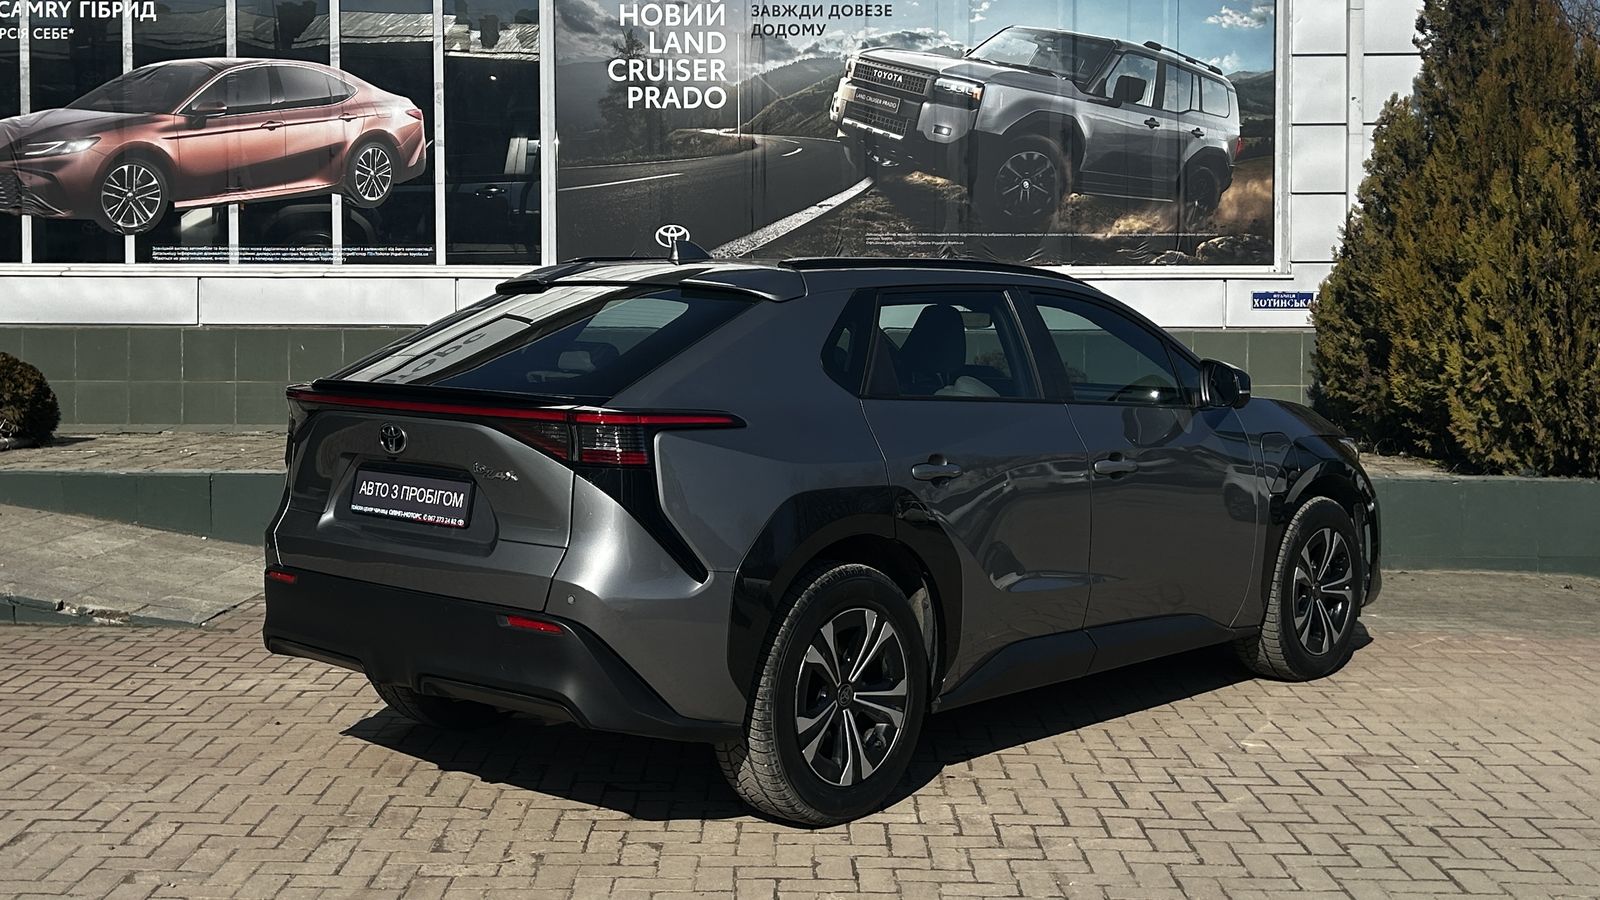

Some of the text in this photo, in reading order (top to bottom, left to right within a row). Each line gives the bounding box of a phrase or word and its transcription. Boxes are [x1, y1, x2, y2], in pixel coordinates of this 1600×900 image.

[0, 1, 157, 21] CAMRY ГІБРИД
[619, 0, 726, 27] НОВИЙ
[751, 4, 893, 19] ЗАВЖДИ ДОВЕЗЕ
[751, 23, 826, 39] ДОДОМУ
[649, 32, 727, 54] LAND
[608, 59, 727, 82] CRUISER
[873, 69, 903, 82] TOYOTA
[628, 87, 727, 109] PRADO
[865, 95, 882, 104] CRUISER
[882, 99, 897, 108] PRADO
[359, 480, 389, 498] АВТО
[400, 486, 464, 508] ПРОБІГОМ
